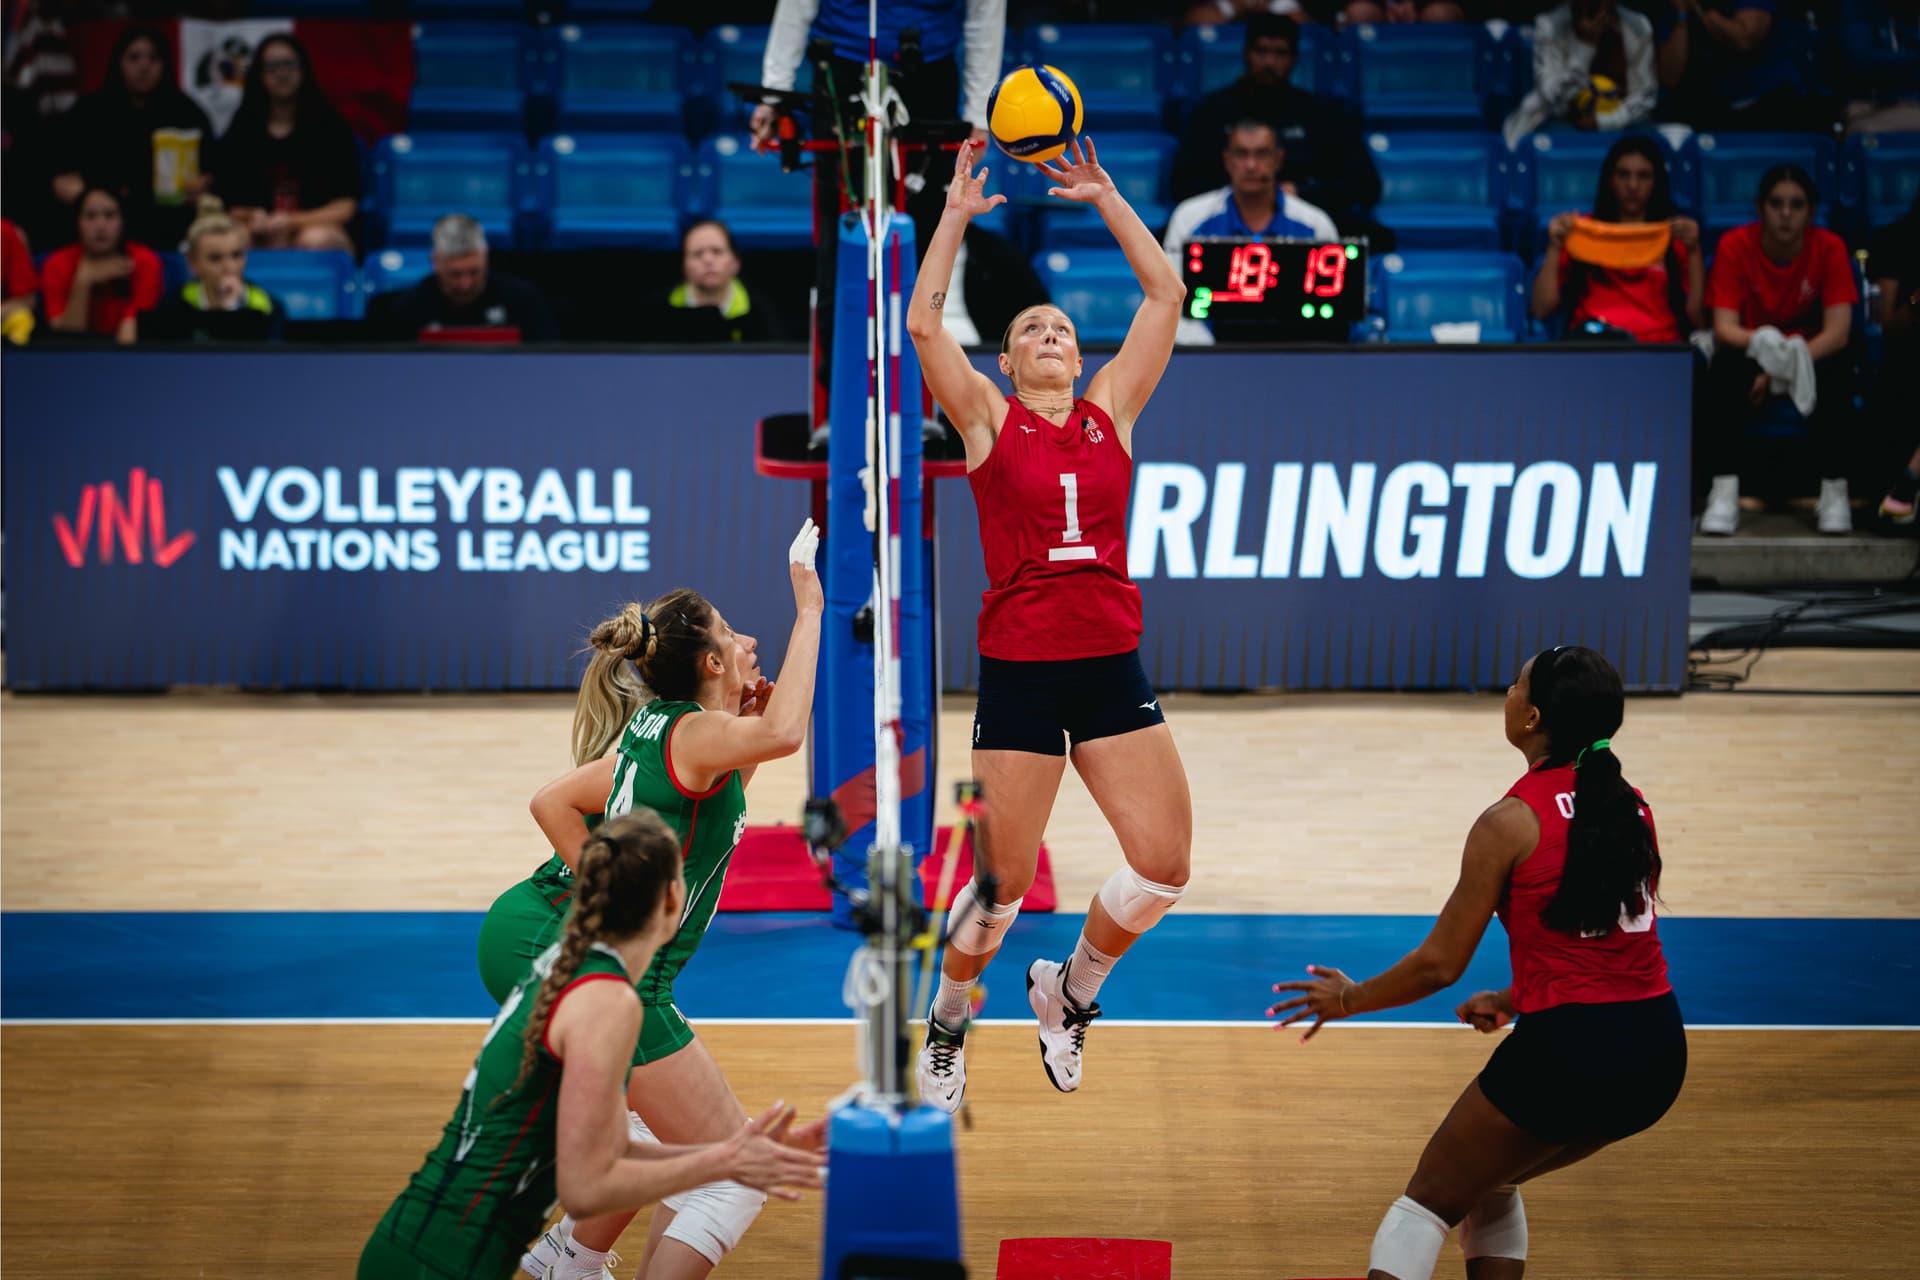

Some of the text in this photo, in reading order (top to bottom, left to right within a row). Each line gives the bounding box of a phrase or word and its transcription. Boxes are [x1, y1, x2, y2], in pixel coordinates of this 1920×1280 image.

[1304, 244, 1347, 297] 19
[54, 467, 196, 568] VNL
[217, 466, 651, 524] VOLLEYBALL
[1060, 473, 1083, 543] 1
[1128, 461, 1658, 580] RLINGTON
[220, 529, 651, 572] NATIONS LEAGUE
